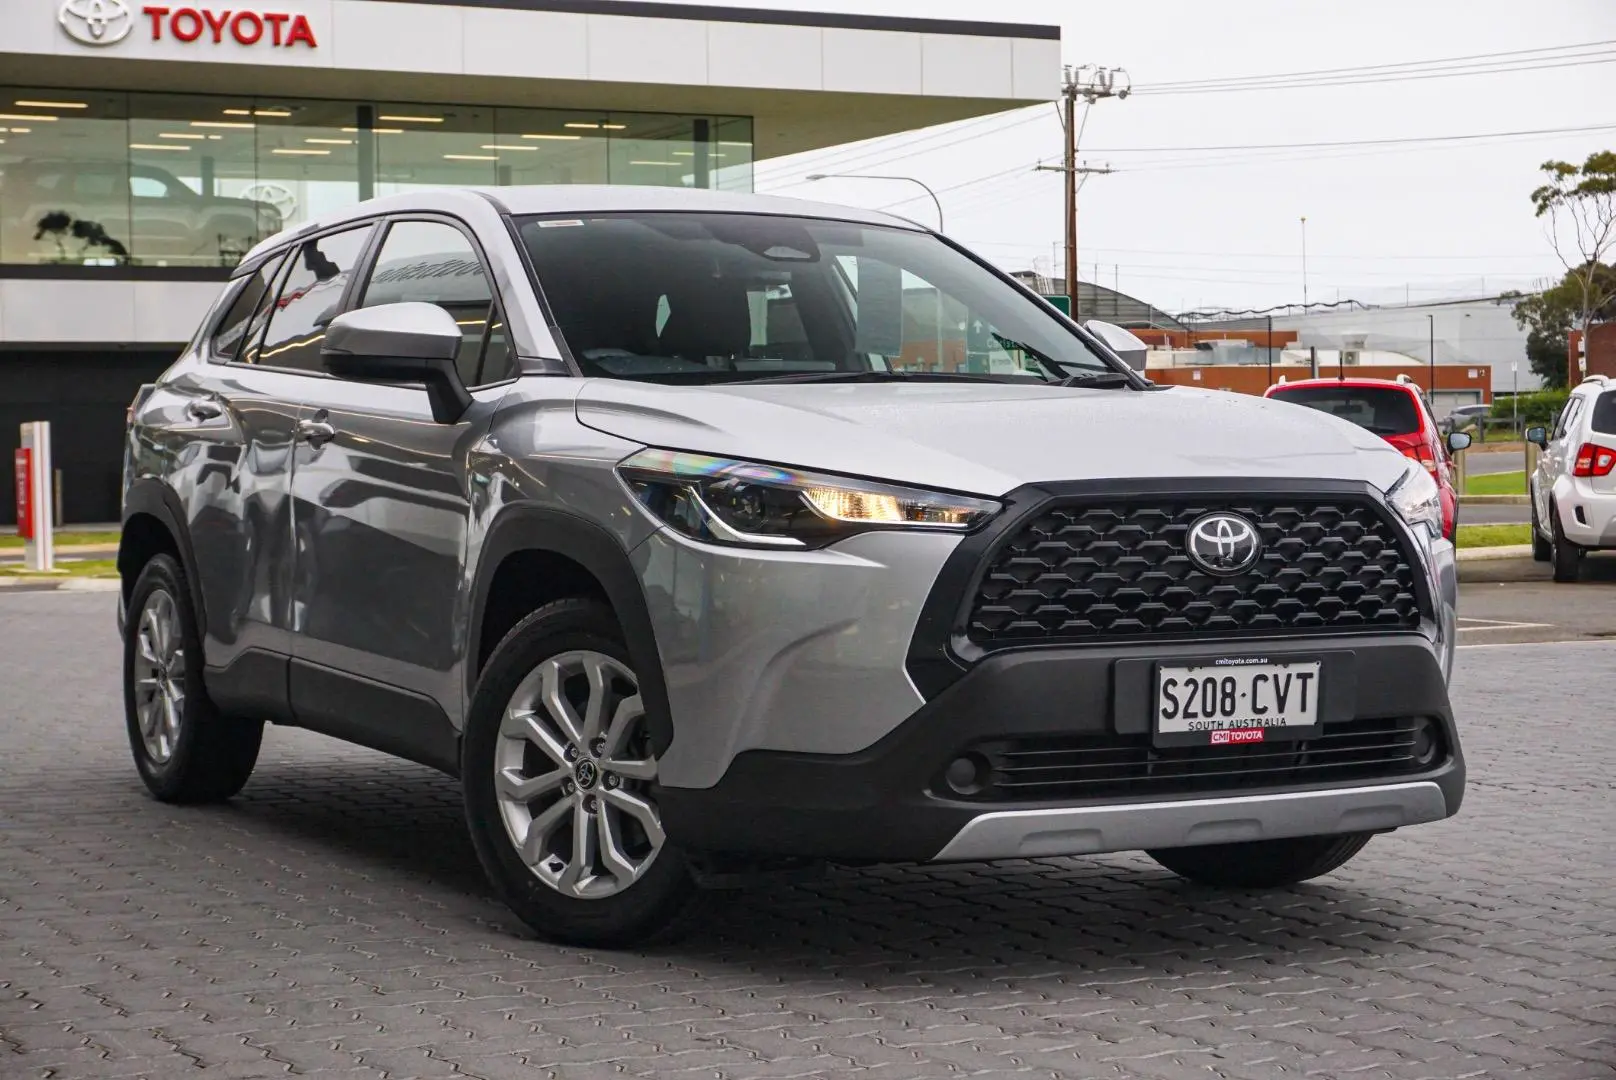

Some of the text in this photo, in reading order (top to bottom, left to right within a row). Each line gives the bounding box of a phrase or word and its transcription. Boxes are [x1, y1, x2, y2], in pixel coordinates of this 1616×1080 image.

[143, 6, 318, 48] TOYOTA
[1215, 657, 1268, 666] cmitoyota.com.au
[1188, 717, 1287, 731] SOUTH AUSTRALIA
[1212, 730, 1263, 742] CMI TOYOTA
